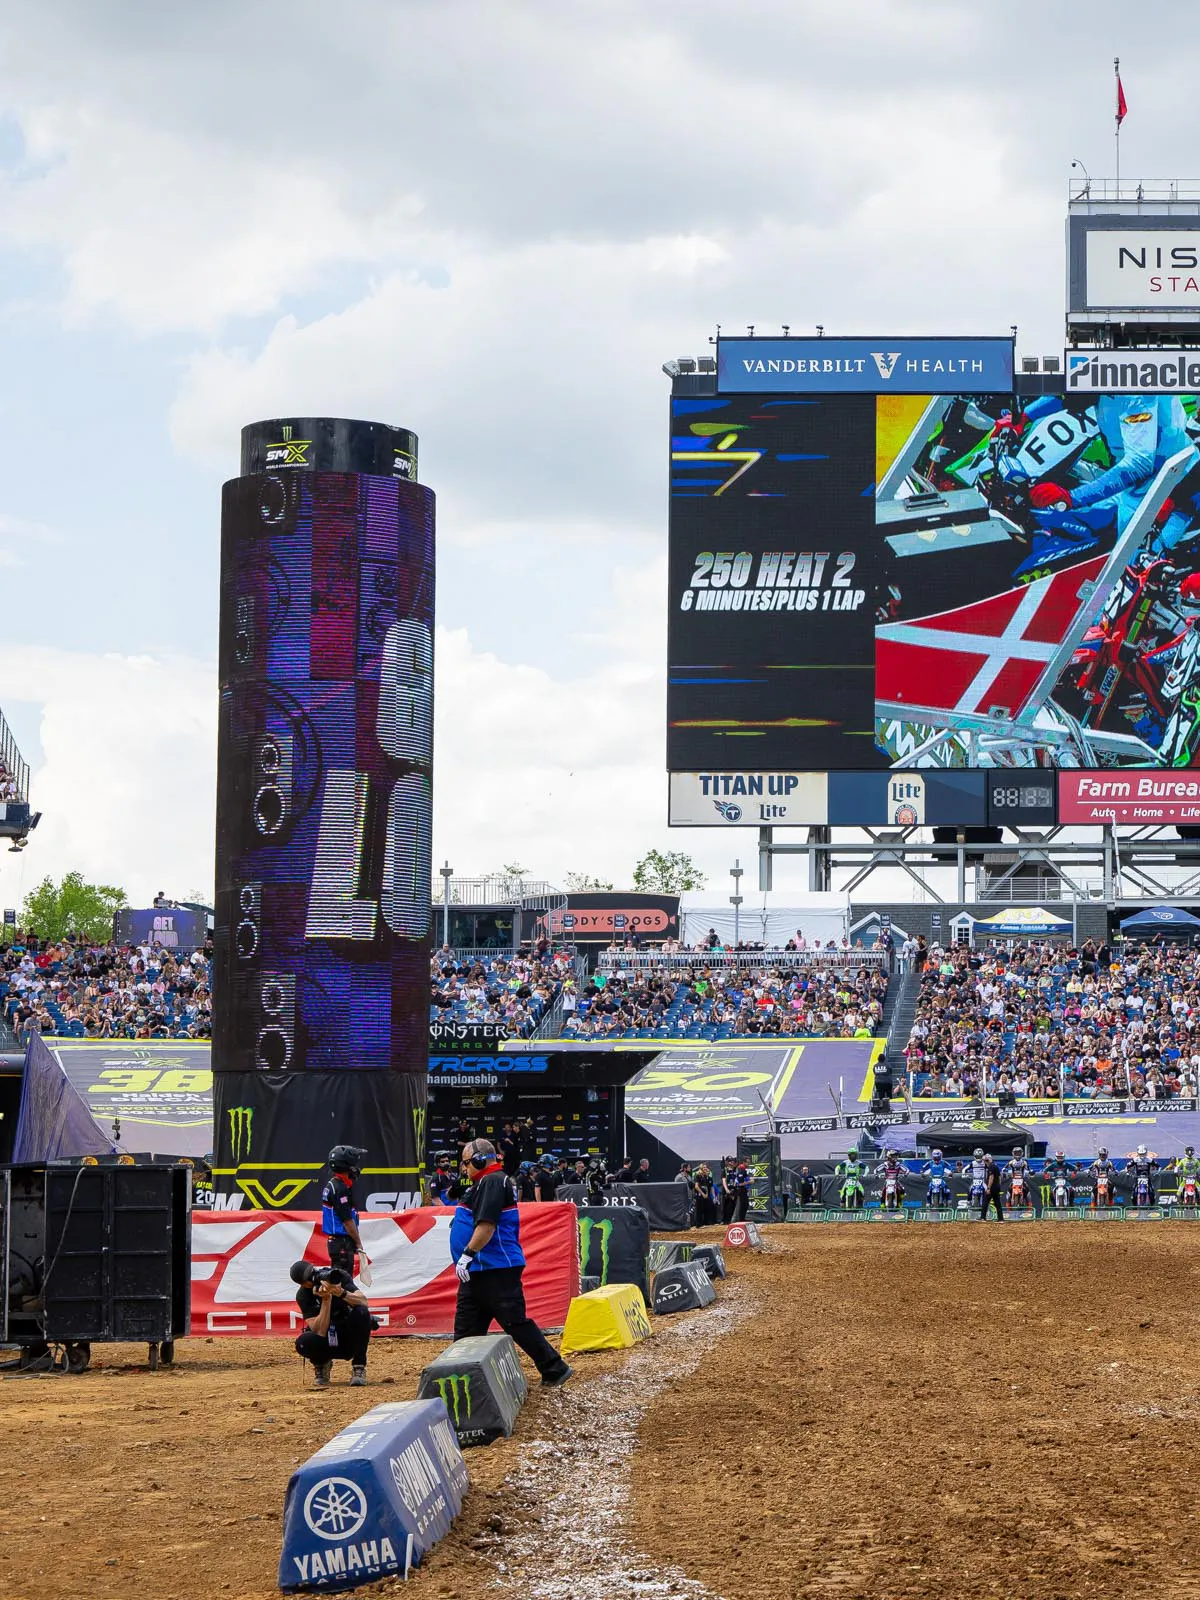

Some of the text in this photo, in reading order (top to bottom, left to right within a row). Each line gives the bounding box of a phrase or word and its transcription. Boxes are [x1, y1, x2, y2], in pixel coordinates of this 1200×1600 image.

[742, 358, 984, 374] VANDERBILT HEALTH
[1024, 411, 1098, 466] FOX
[266, 445, 309, 462] SMX
[690, 551, 857, 588] 250 HEAT 2
[680, 589, 866, 611] 6 MINUTES/PLUS 1 LAP
[699, 775, 799, 796] TITAN UP
[892, 783, 921, 802] Lite
[1078, 778, 1131, 797] Farm
[758, 802, 787, 820] Lite
[1091, 807, 1116, 818] Auto
[1134, 807, 1163, 818] Home
[1180, 807, 1200, 818] Life
[153, 917, 173, 930] GET
[429, 1022, 508, 1039] ONSTER
[428, 1056, 549, 1071] RCROSS
[88, 1070, 213, 1092] 38
[427, 1073, 498, 1086] hampionship
[625, 1072, 773, 1092] 30
[952, 1122, 992, 1131] SMX
[365, 1191, 422, 1212] SM
[580, 1197, 636, 1207] SORTS
[1158, 1196, 1178, 1204] SM
[656, 1288, 688, 1304] OAKLEY
[458, 1429, 486, 1440] STER
[293, 1537, 398, 1580] YAMAHA
